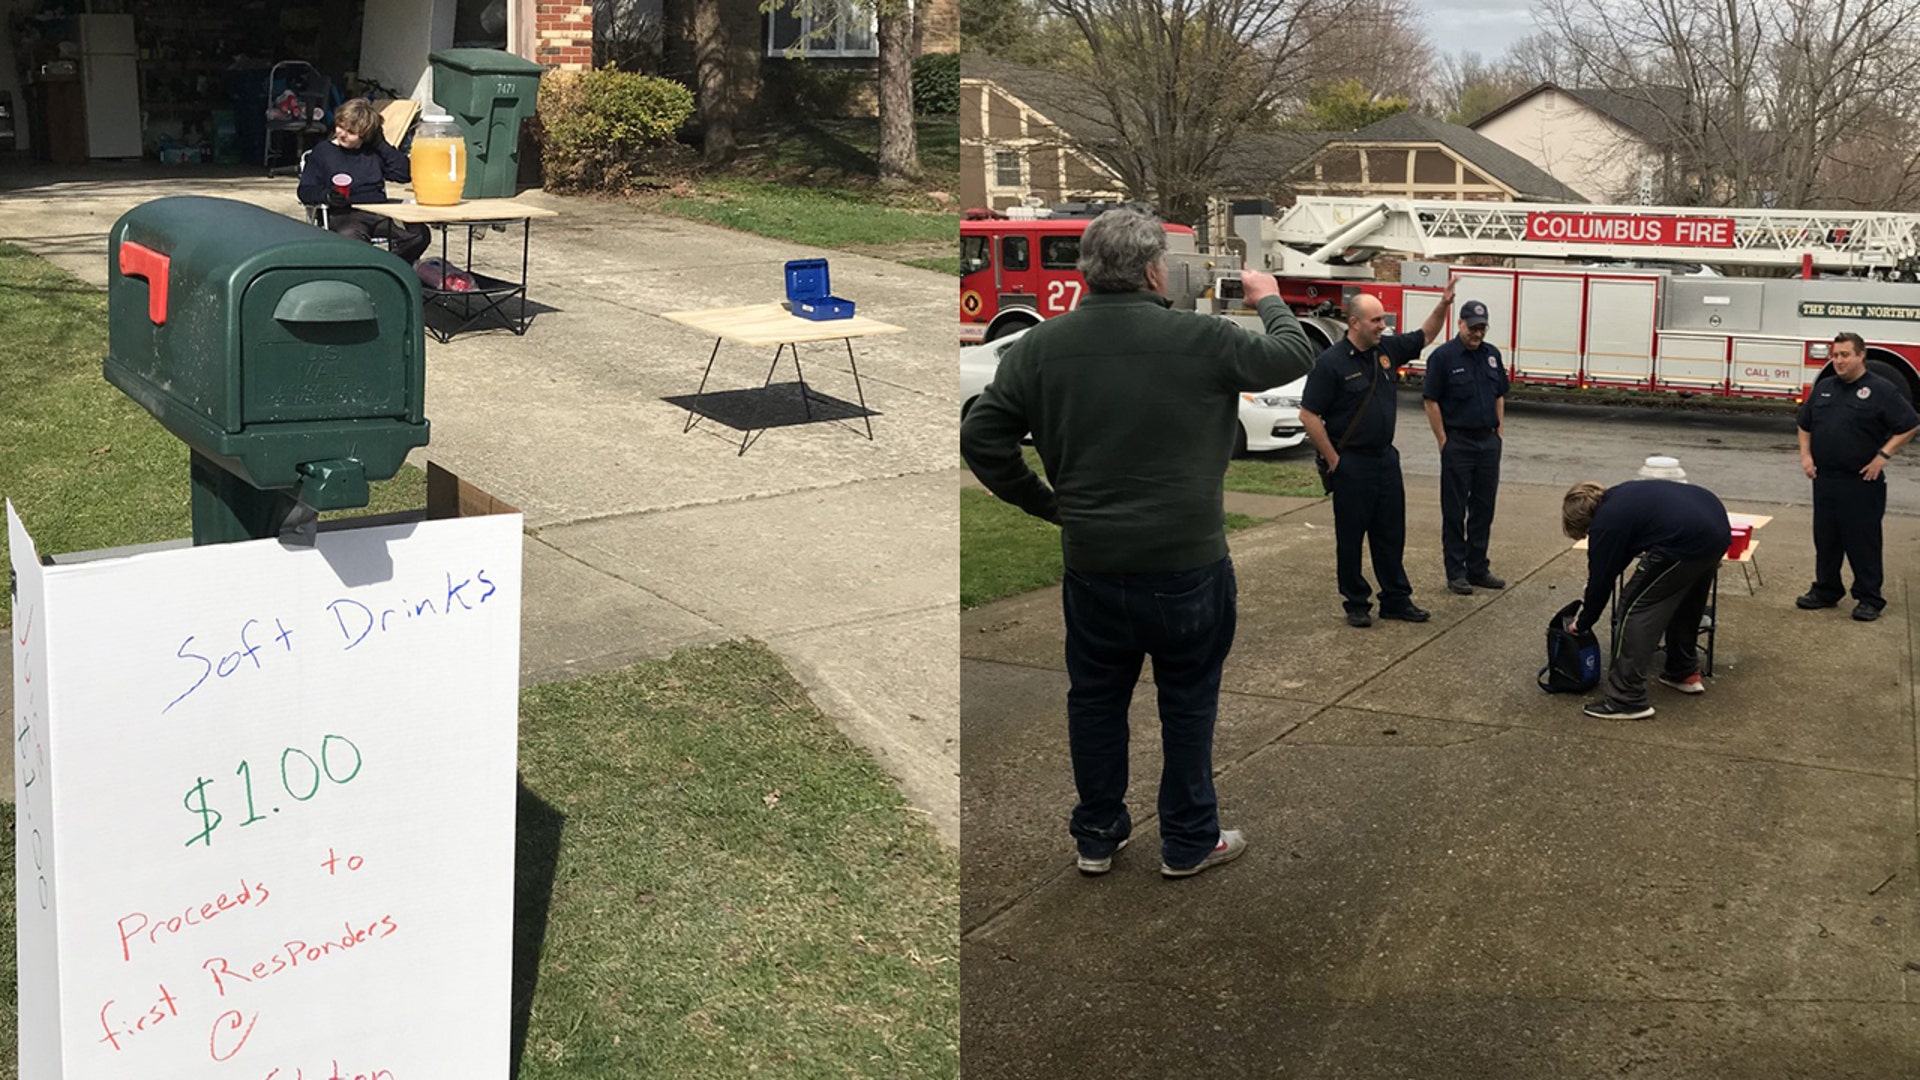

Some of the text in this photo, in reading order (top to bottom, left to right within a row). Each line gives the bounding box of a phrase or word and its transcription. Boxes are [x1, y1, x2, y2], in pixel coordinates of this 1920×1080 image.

[1532, 216, 1728, 243] COLUMBUS FIRE
[1048, 280, 1082, 311] 27
[1803, 304, 1825, 315] THE
[1828, 305, 1864, 316] GREAT
[1744, 367, 1790, 378] CALL 911
[161, 569, 496, 715] Soft Drinks
[184, 734, 362, 847] $1.00
[117, 847, 365, 962] Proceeds to
